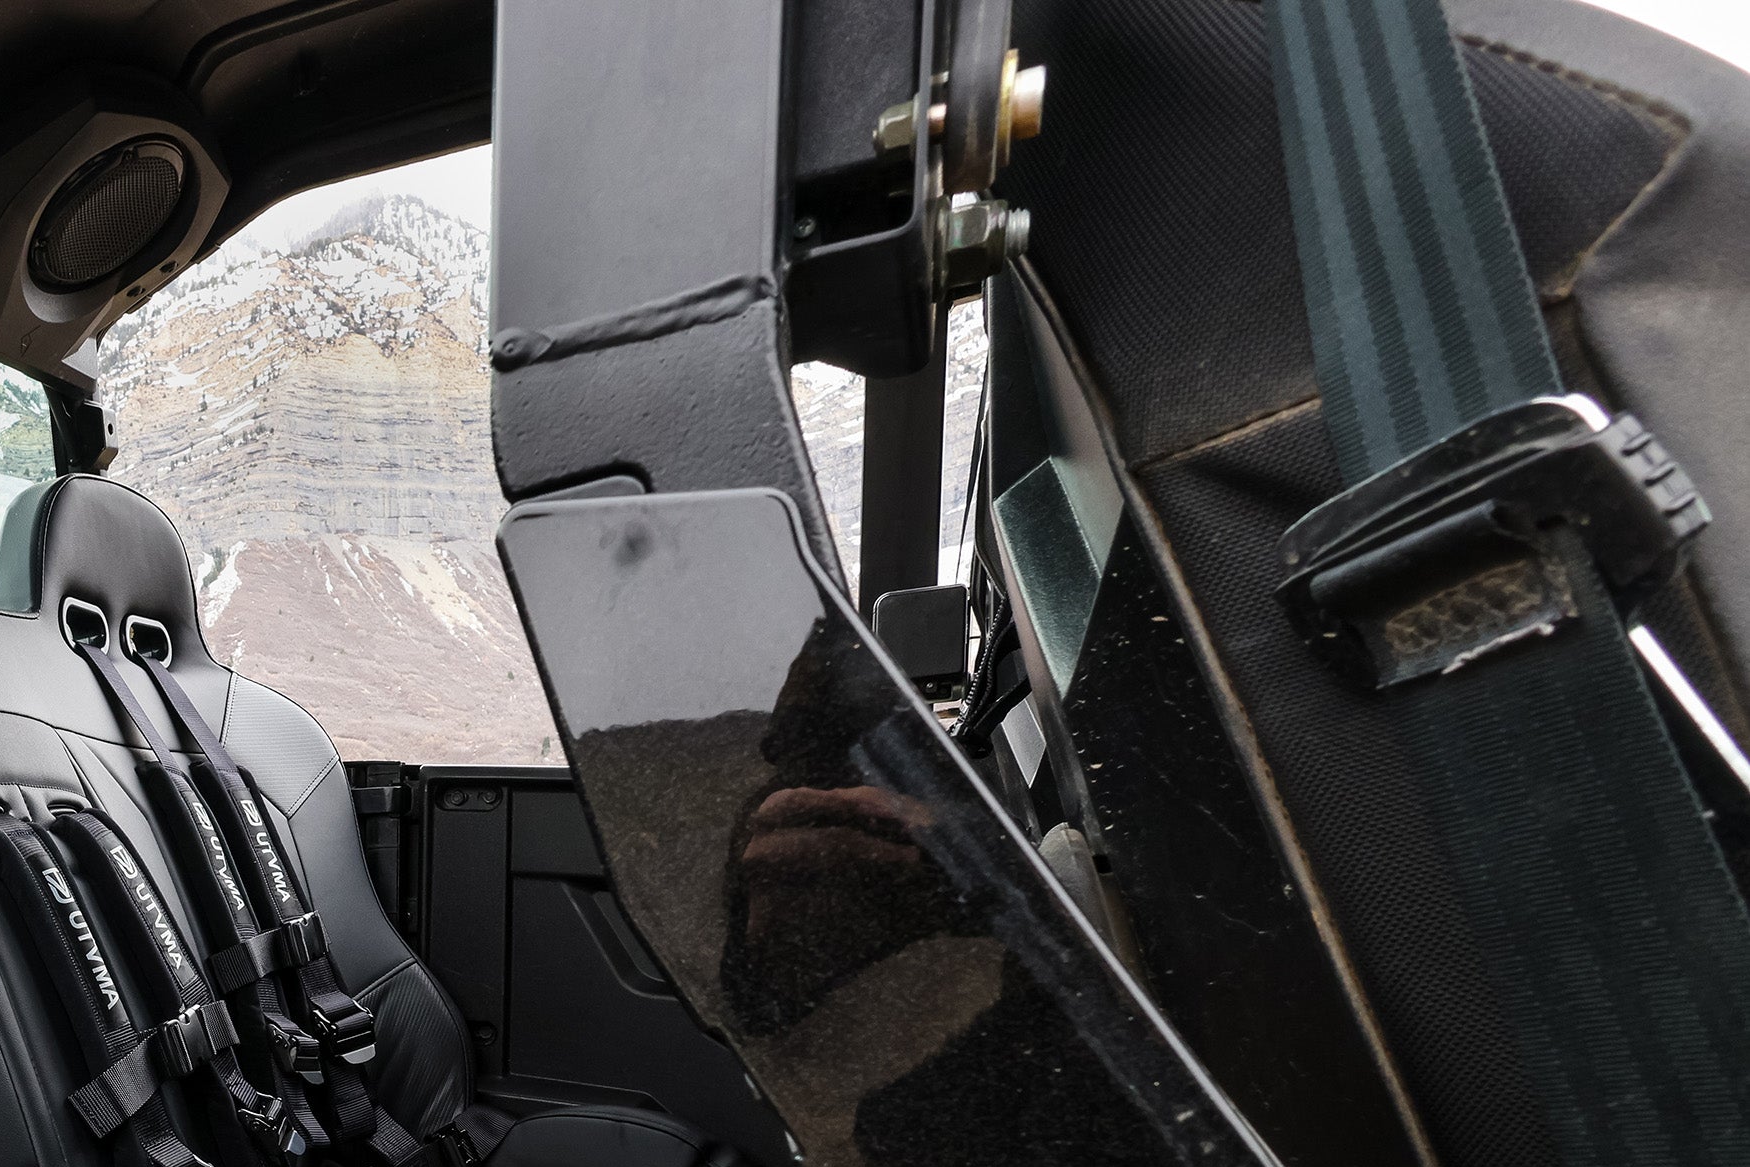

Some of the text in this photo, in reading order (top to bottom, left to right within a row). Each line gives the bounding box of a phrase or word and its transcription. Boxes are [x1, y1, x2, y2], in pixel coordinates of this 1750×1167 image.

[210, 836, 245, 911] UTVMA
[256, 832, 291, 903] UTVMA
[68, 911, 120, 1010] UTVMA
[135, 883, 183, 970] UTVMA
